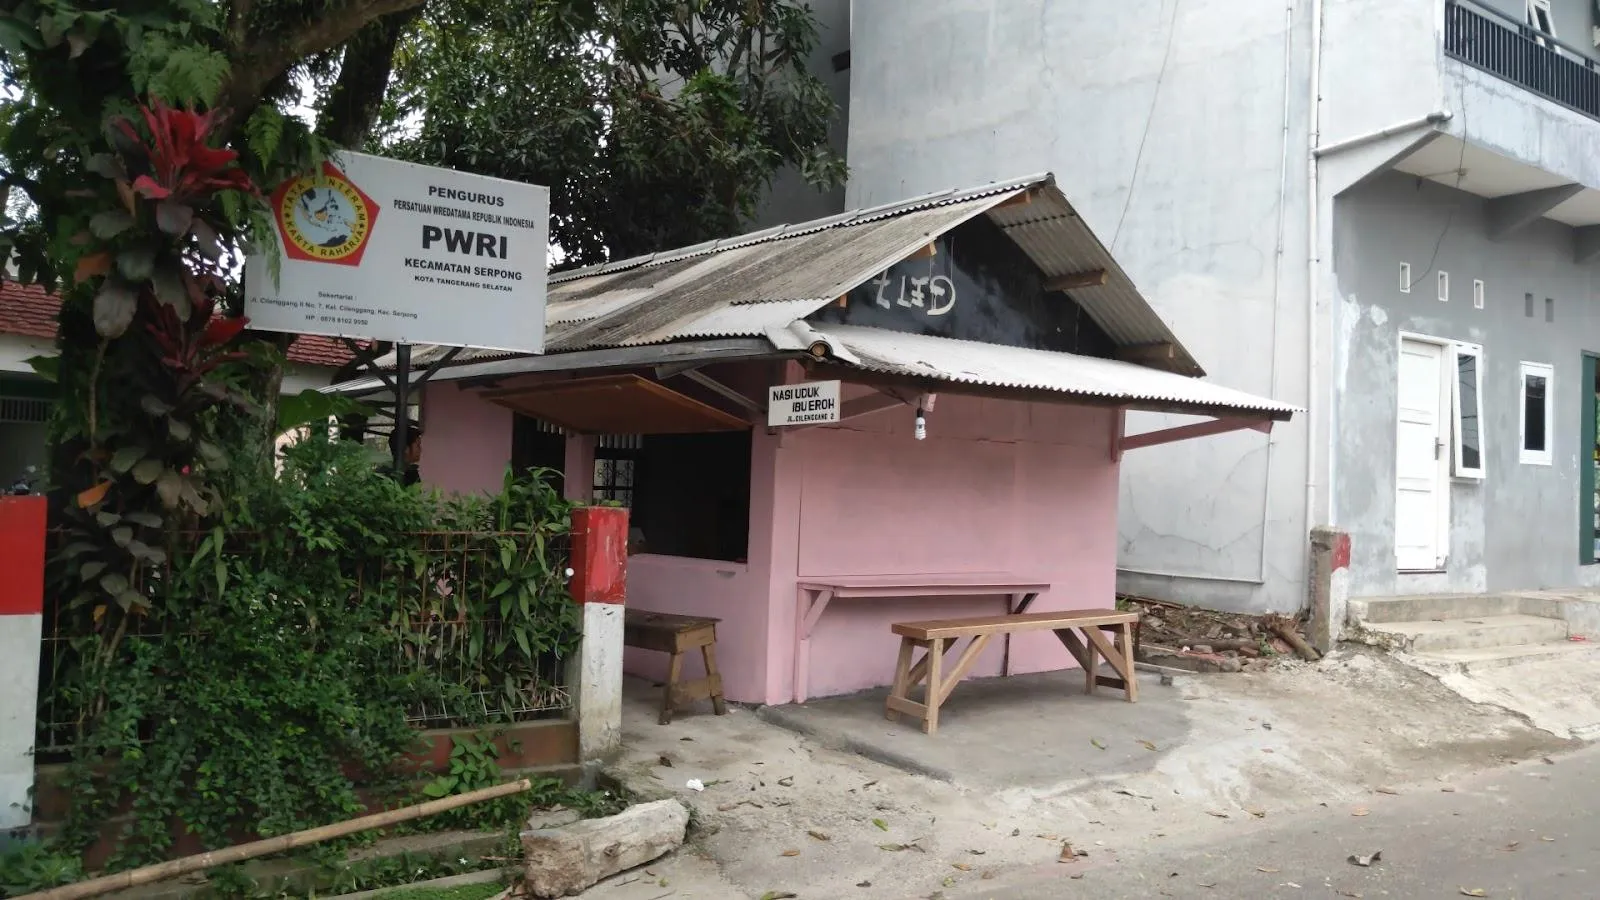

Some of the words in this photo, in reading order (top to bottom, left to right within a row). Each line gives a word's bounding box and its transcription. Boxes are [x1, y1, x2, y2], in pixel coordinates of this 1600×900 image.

[428, 185, 505, 208] PENGURUS
[393, 199, 432, 215] PERSATUAN
[433, 205, 471, 220] WREDATAMA
[472, 211, 502, 225] REPUBLIK
[503, 215, 534, 229] INDONESIA
[285, 221, 315, 253] KARTA
[320, 229, 364, 257] RAHARJA
[422, 224, 508, 260] PWRI
[404, 257, 471, 274] KECAMATAN
[474, 266, 522, 281] SERPONG
[414, 275, 434, 284] KOTA
[436, 277, 480, 289] TANGERANG
[482, 282, 513, 292] SELATAN
[392, 310, 418, 319] Serpong
[772, 389, 793, 401] NASI
[794, 386, 819, 399] UDUK
[792, 400, 807, 413] IBU
[808, 397, 835, 411] EROH
